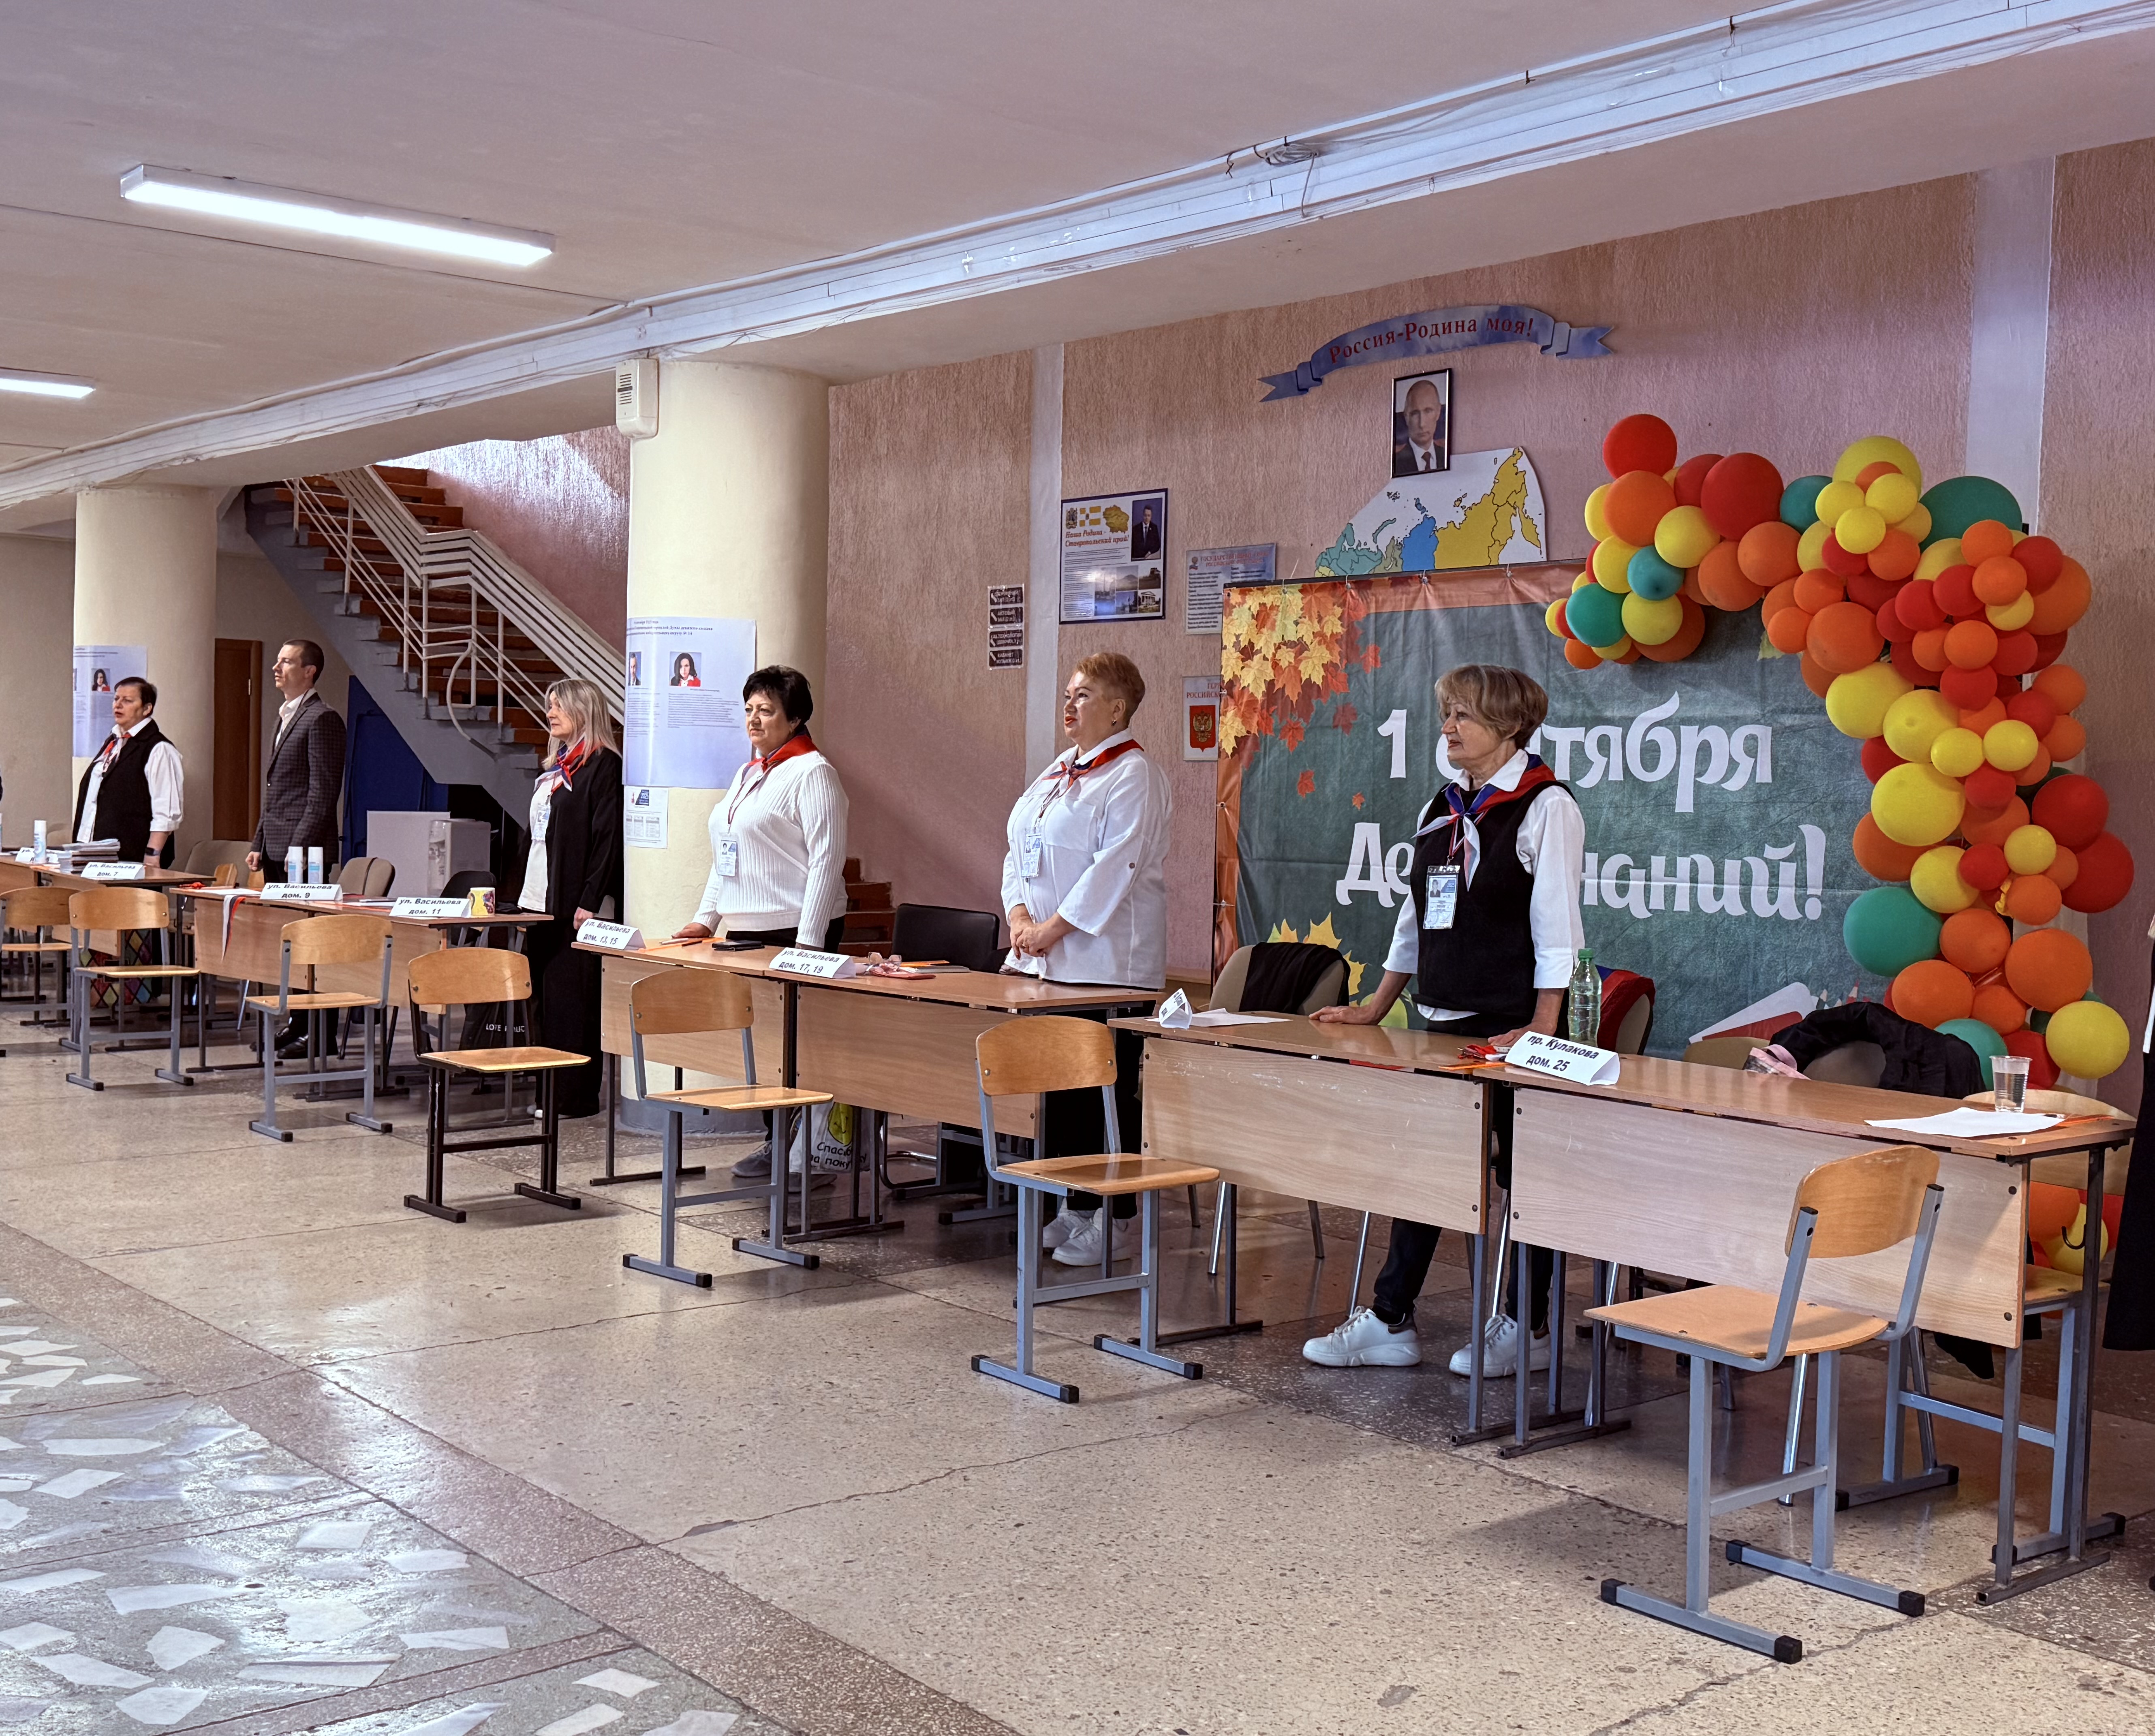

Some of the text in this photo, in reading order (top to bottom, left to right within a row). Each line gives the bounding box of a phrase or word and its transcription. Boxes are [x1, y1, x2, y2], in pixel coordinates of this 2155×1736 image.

[1329, 317, 1534, 364] Россия-Родина моя!
[1378, 709, 1407, 778] 1
[1336, 822, 1415, 908] Де
[597, 922, 631, 934] Васильева
[583, 934, 597, 942] дом.
[796, 951, 840, 962] Васильева
[800, 963, 810, 974] 17,
[813, 965, 823, 973] 19
[1527, 1036, 1599, 1059] пр. Кулакова
[1526, 1055, 1571, 1071] дом. 25
[817, 1142, 851, 1156] Спасб
[825, 1154, 867, 1169] покуу
